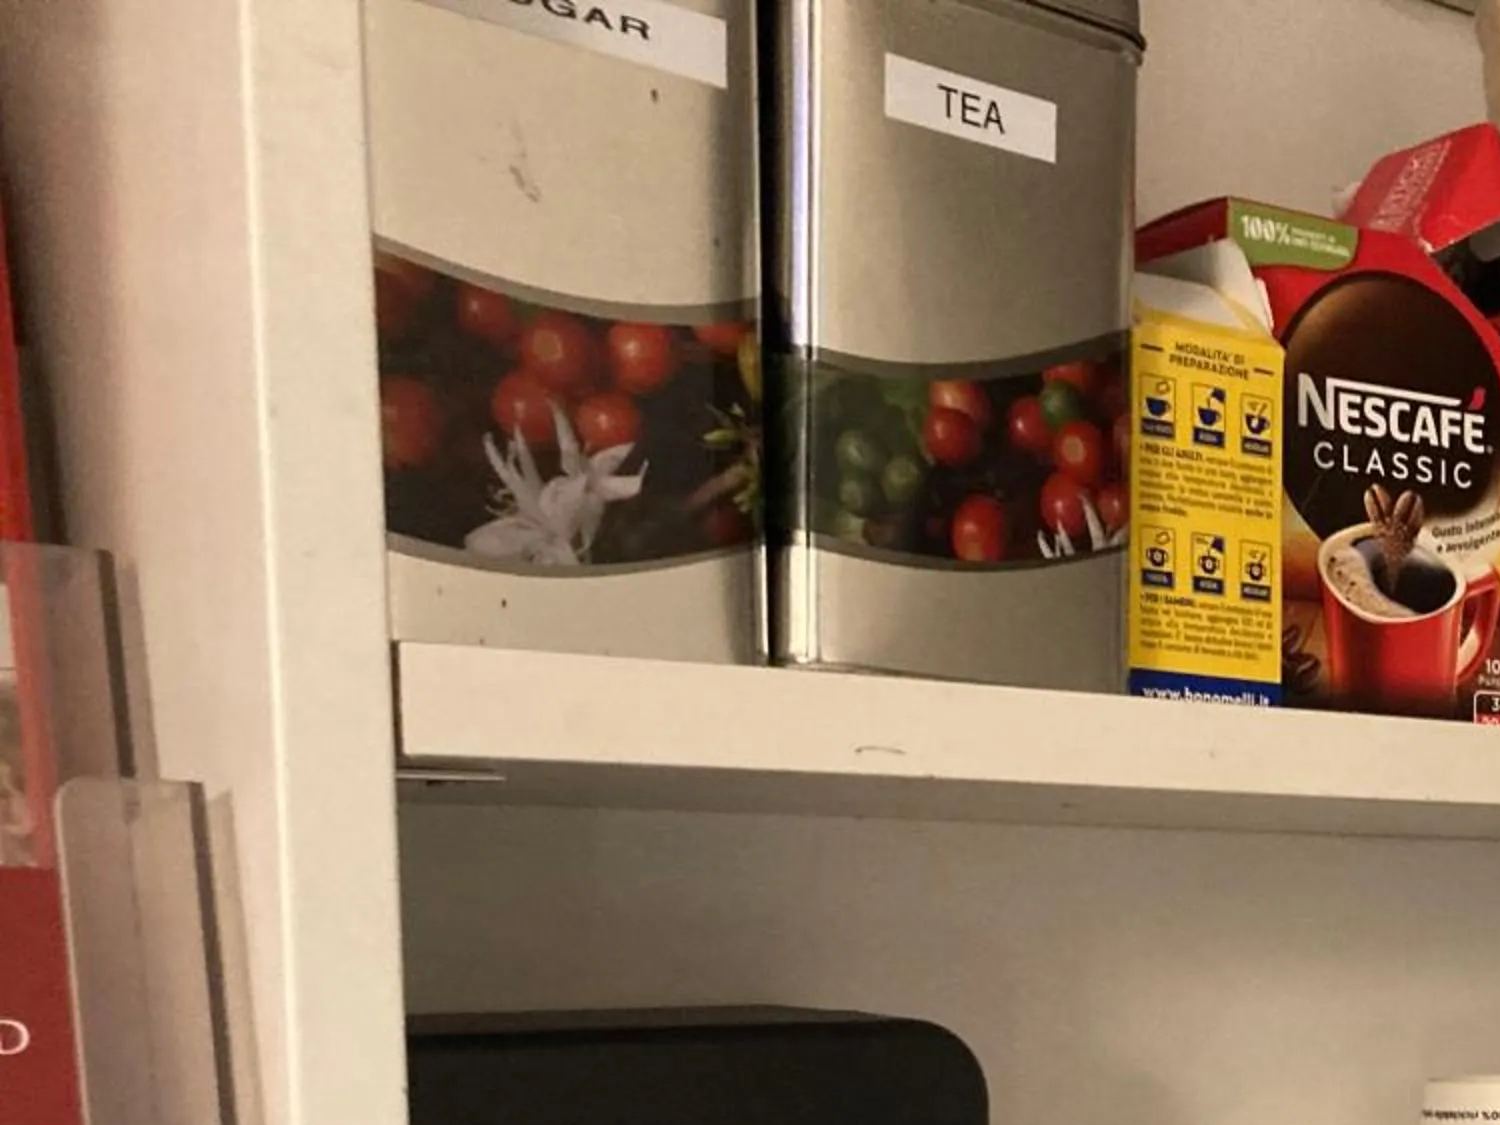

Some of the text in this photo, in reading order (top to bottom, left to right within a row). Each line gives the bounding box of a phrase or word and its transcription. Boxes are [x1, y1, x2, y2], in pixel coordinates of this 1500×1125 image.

[508, 0, 650, 40] GAR
[937, 83, 1005, 134] TEA
[1241, 215, 1290, 245] 100%
[1297, 372, 1486, 455] NESCAFÉ
[1313, 441, 1473, 489] CLASSIC
